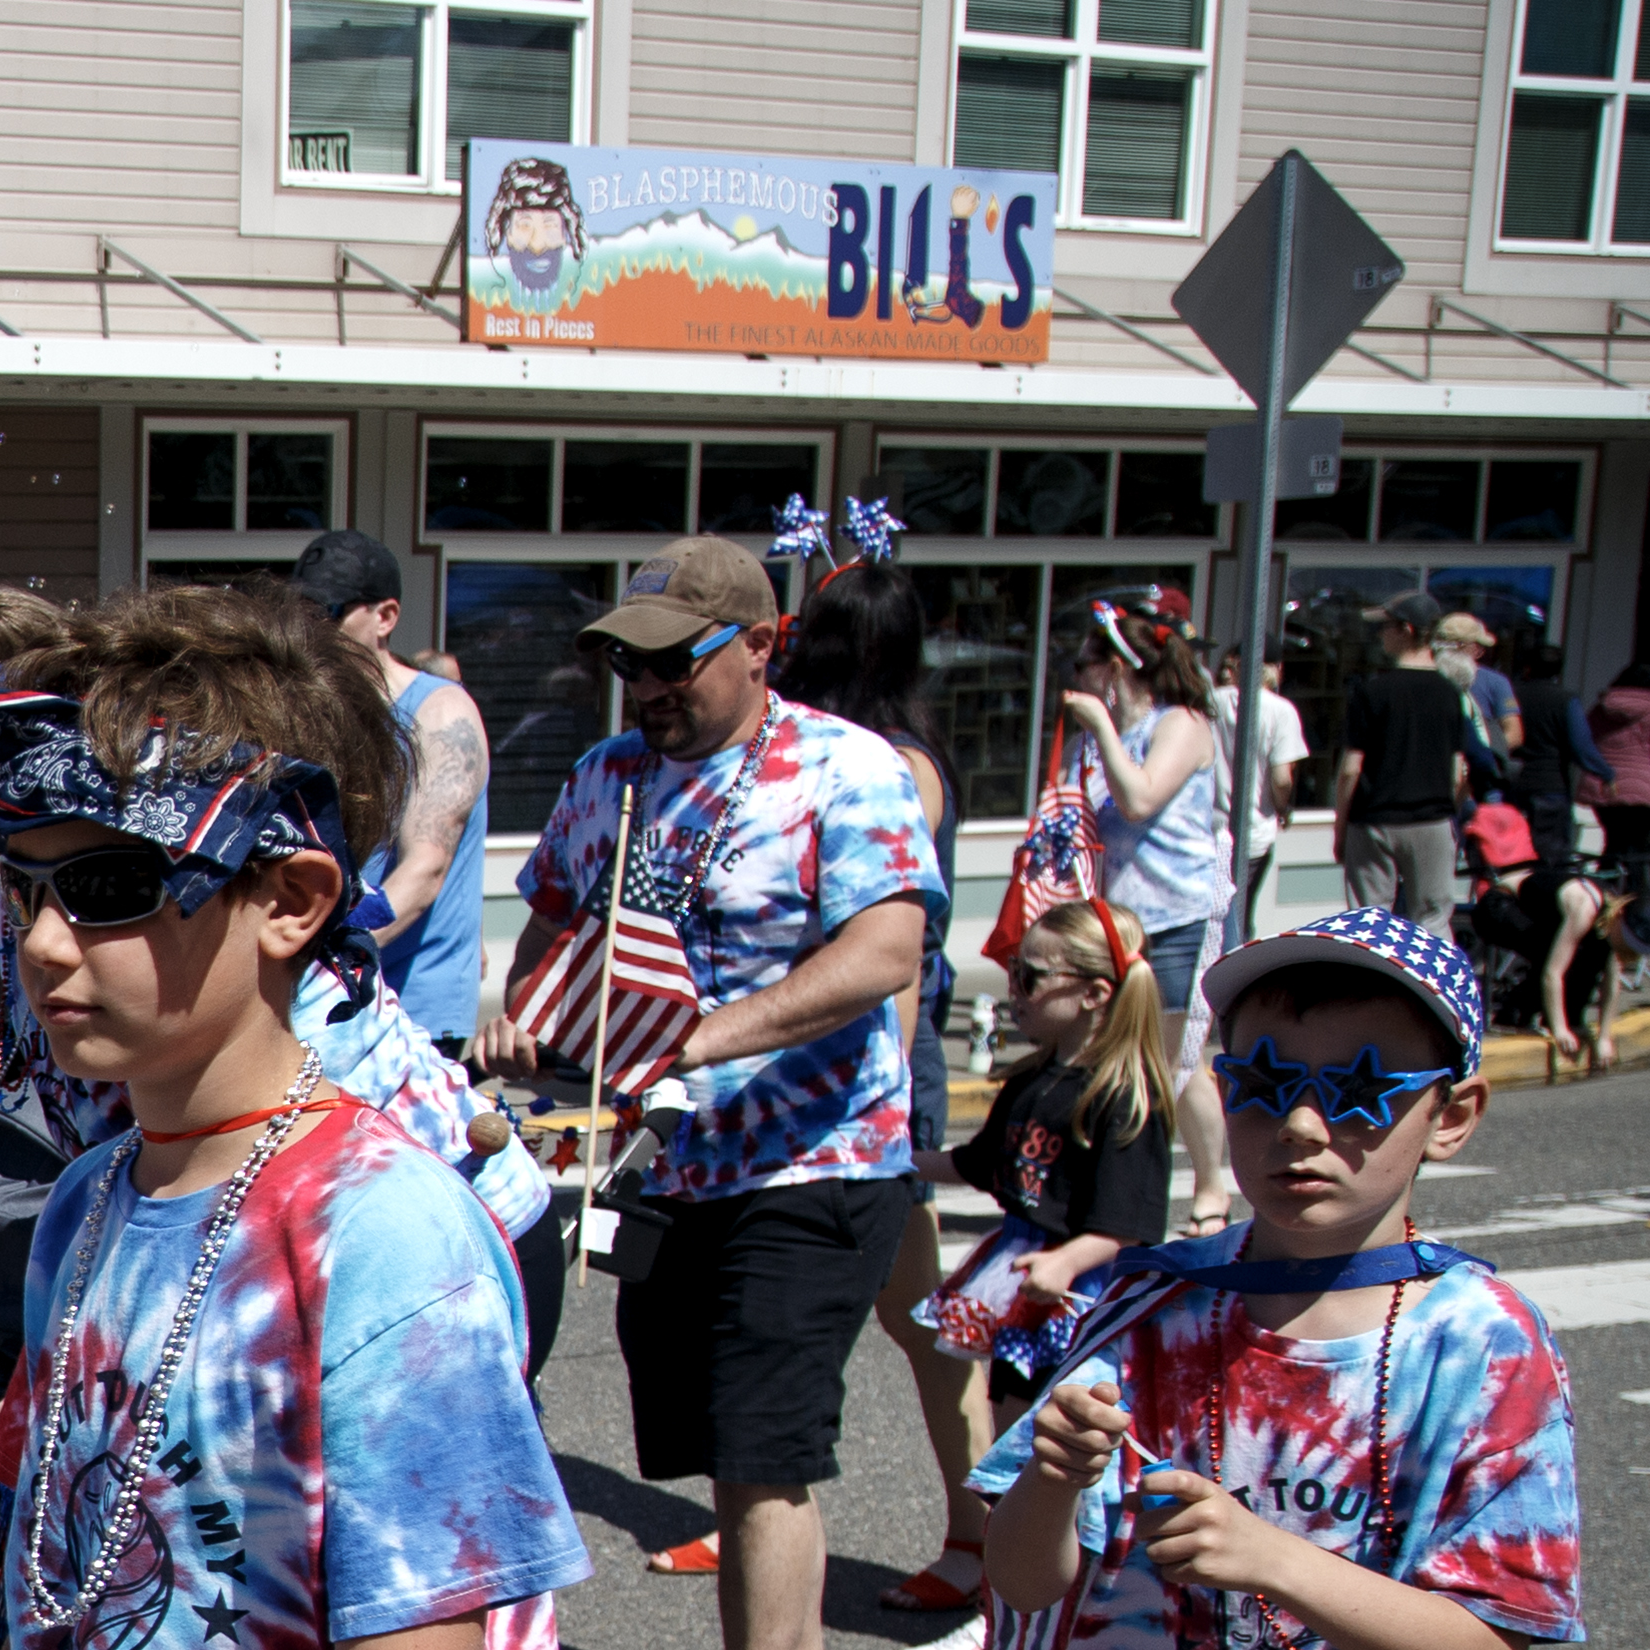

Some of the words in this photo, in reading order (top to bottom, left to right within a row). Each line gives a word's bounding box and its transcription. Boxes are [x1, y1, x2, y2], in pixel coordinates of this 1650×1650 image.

[307, 137, 348, 173] RENT
[587, 165, 840, 228] BLASPHEMOUS
[827, 182, 1036, 332] BILL'S
[485, 312, 522, 338] Rest
[544, 314, 596, 341] Pieces
[685, 321, 721, 344] THE
[730, 323, 797, 347] FINEST
[804, 328, 898, 350] ALASKAN
[906, 331, 962, 353] MADE
[969, 333, 1041, 356] GOODS
[1314, 459, 1331, 476] 18
[676, 826, 746, 874] FRE
[191, 1501, 247, 1585] MY
